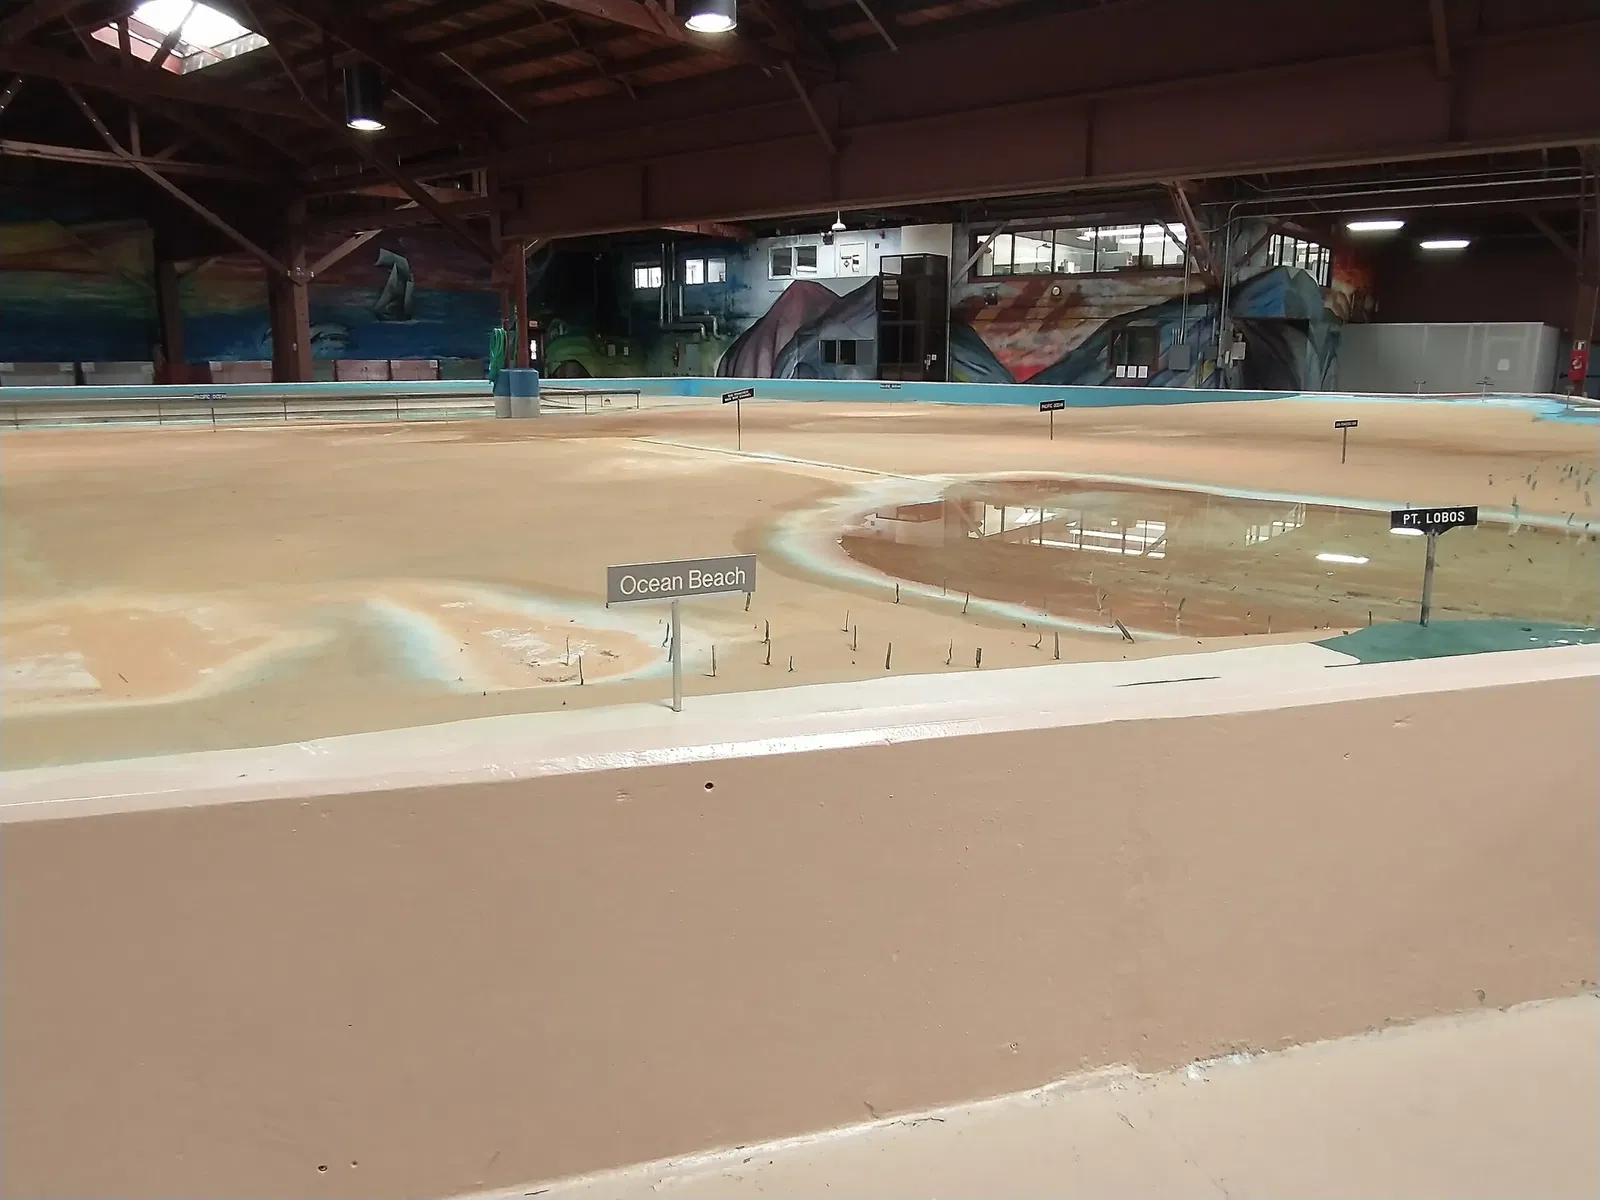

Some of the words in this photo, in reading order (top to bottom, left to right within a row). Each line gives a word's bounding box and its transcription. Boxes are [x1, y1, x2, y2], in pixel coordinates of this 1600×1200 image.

[1403, 513, 1421, 525] PT.
[1426, 510, 1465, 524] LOBOS
[620, 575, 683, 595] Ocean
[689, 566, 746, 589] Beach
